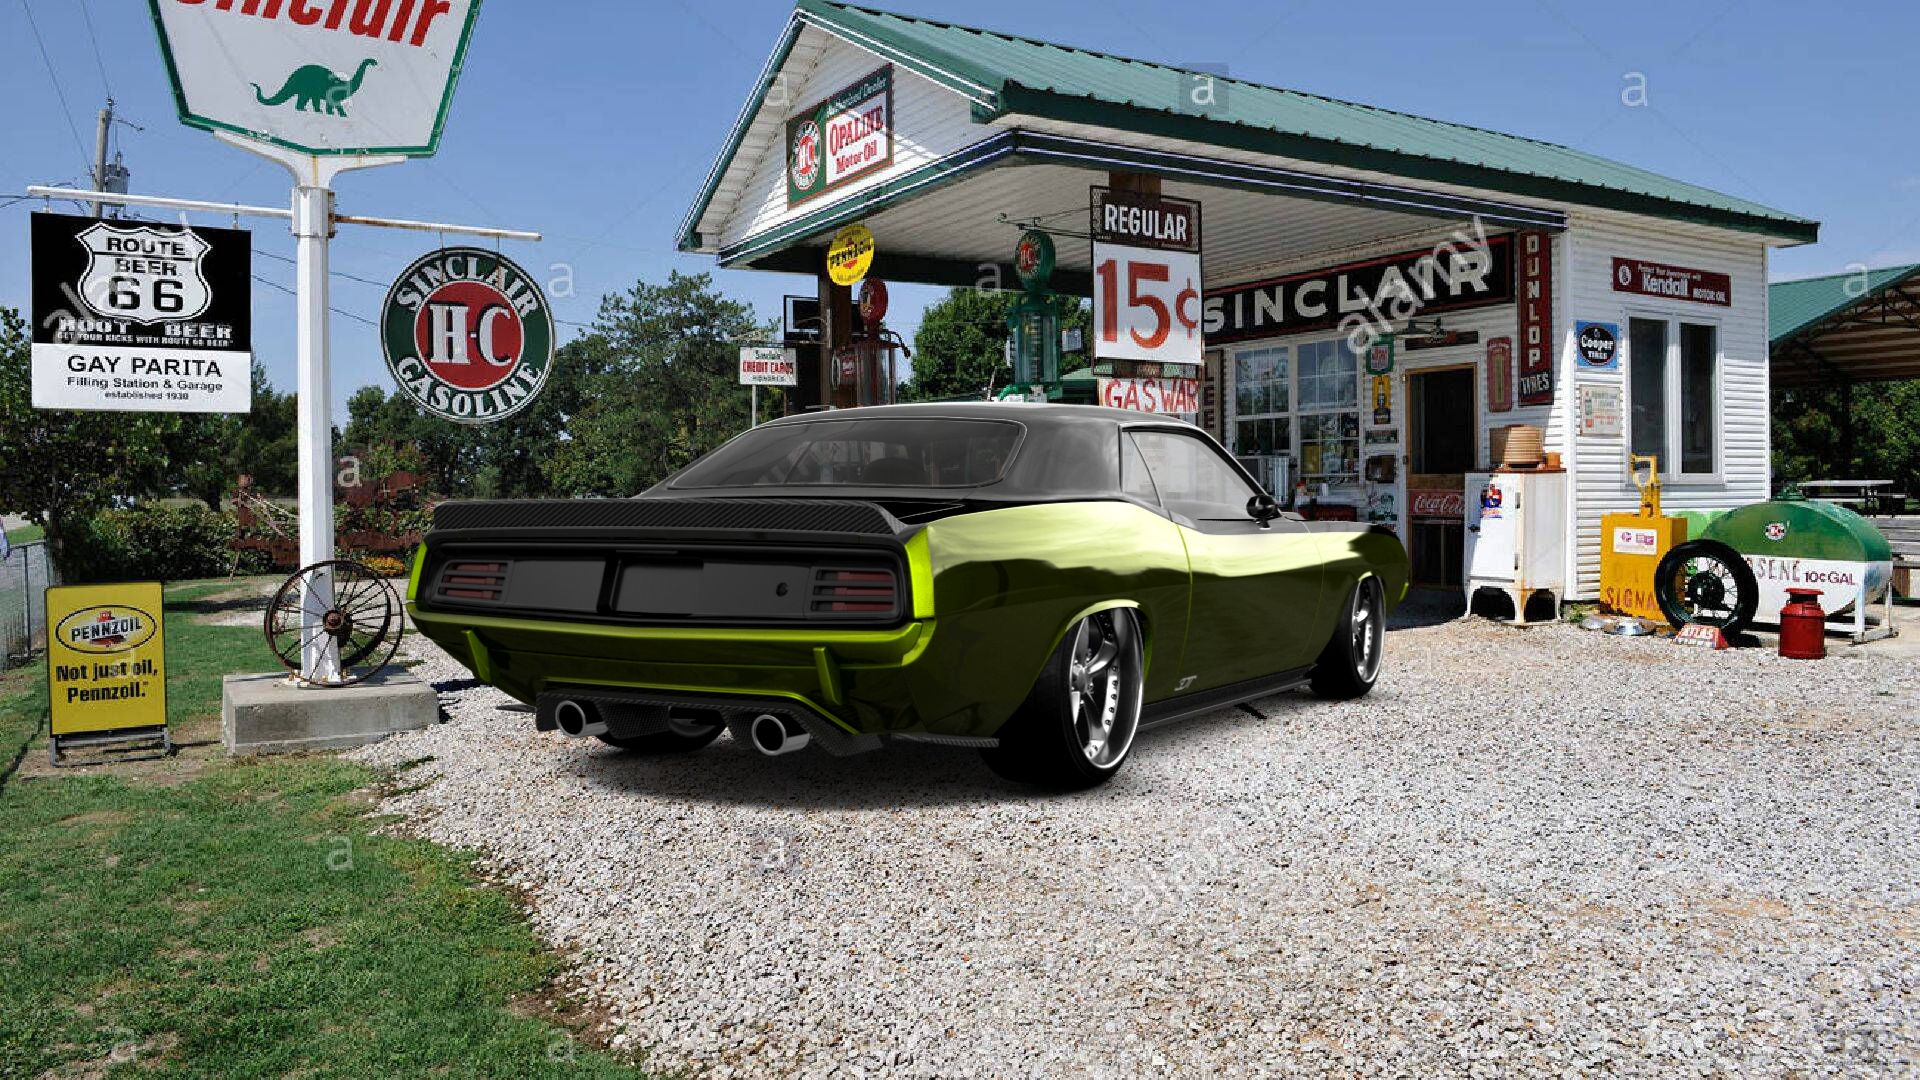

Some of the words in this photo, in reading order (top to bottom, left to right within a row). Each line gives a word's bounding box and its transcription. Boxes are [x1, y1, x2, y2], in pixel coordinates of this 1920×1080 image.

[830, 105, 884, 156] OPALINE
[836, 151, 862, 174] Motor
[863, 139, 878, 161] Oil
[1104, 203, 1187, 241] REGULAR
[107, 237, 186, 256] ROUTE
[115, 259, 177, 275] BEER
[108, 276, 184, 312] 66
[397, 256, 538, 318] SINCLAIR
[1203, 250, 1489, 333] SINCLAIR
[1642, 272, 1688, 296] Kendall
[1096, 258, 1199, 349] 15¢
[1526, 233, 1542, 368] DUNLOP
[164, 322, 233, 340] BEER
[1581, 334, 1614, 351] Cooper
[67, 355, 121, 373] GAY
[131, 356, 222, 377] PARITA
[742, 361, 768, 373] CREDIT
[1588, 351, 1607, 360] TIRES
[67, 376, 109, 389] Filling
[113, 377, 159, 389] Station
[163, 379, 172, 389] &
[177, 379, 223, 392] Garage
[104, 391, 163, 401] established
[397, 356, 542, 417] GASOLINE
[1104, 377, 1157, 413] GAS
[1159, 377, 1201, 413] WAR
[1520, 372, 1551, 396] TIRES
[1827, 572, 1855, 586] GAL
[1606, 587, 1658, 610] SIGNA
[71, 617, 142, 642] PENNZOIL
[56, 664, 88, 682] Not
[92, 662, 128, 682] just
[131, 659, 158, 677] oil,
